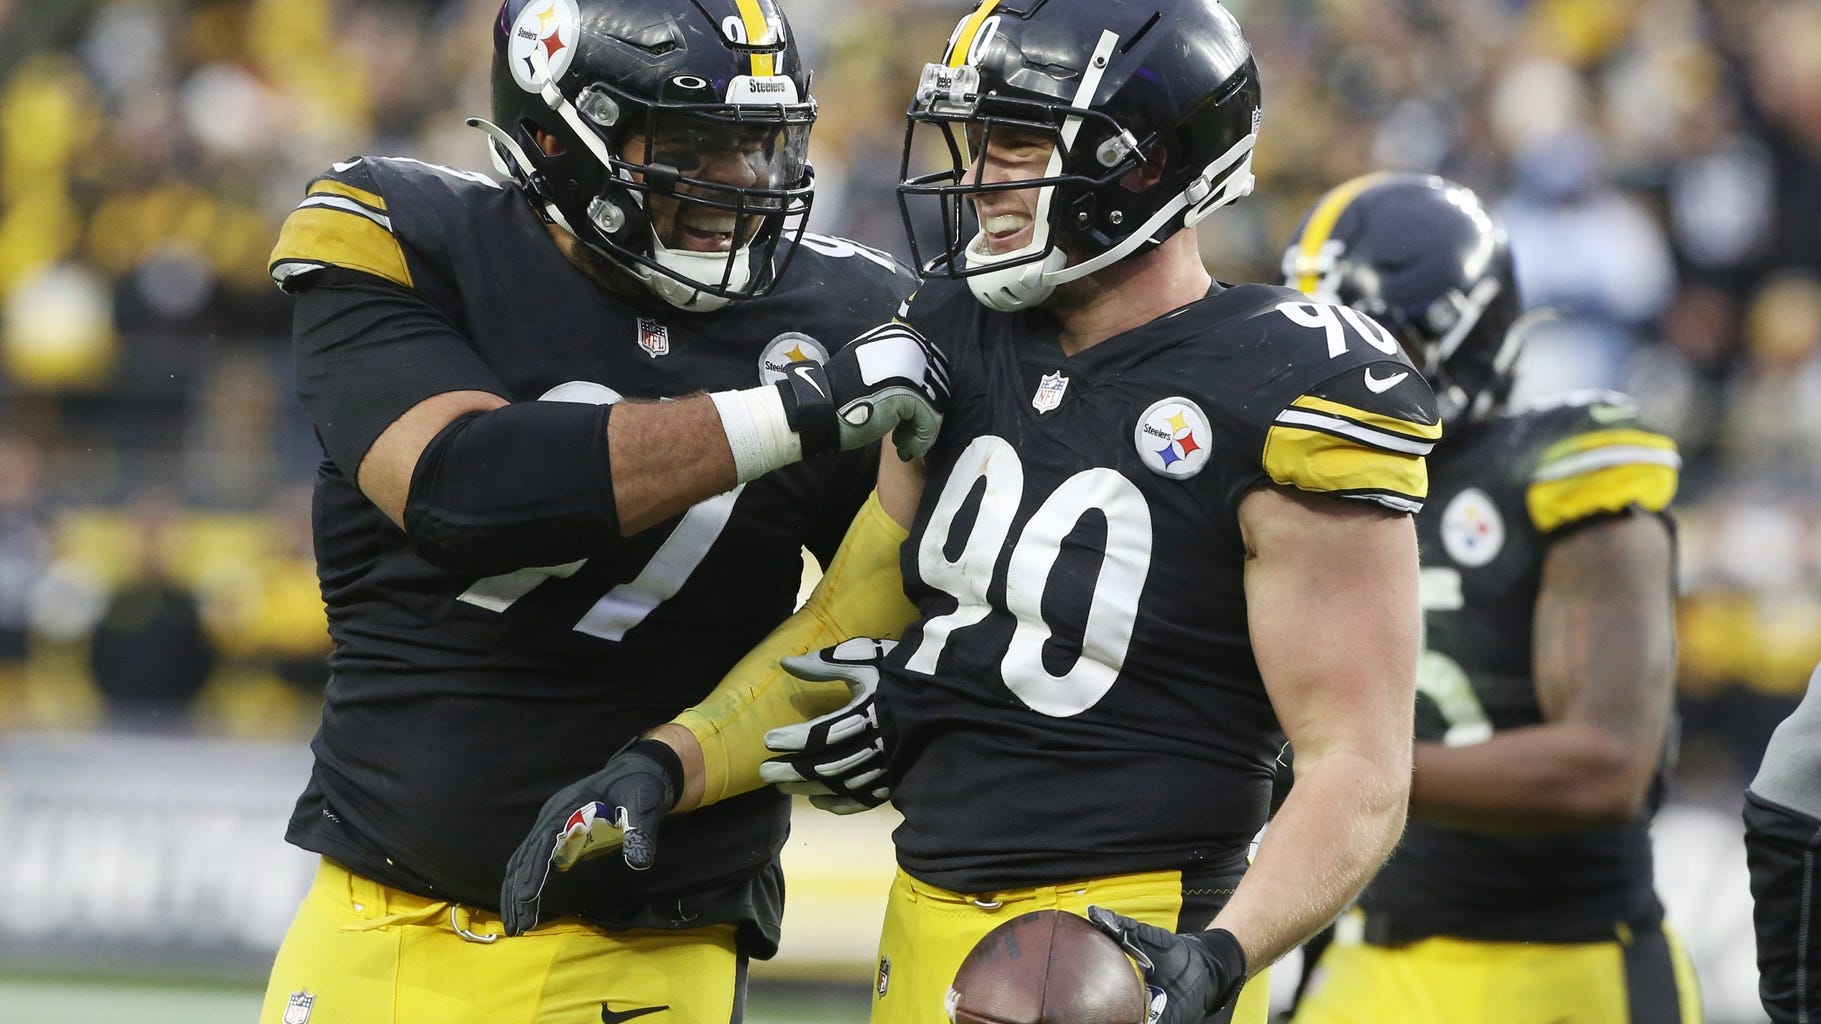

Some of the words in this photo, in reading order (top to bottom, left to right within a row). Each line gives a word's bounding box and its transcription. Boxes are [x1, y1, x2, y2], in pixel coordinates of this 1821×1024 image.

[749, 78, 786, 94] Steelers
[1274, 301, 1398, 360] 90
[765, 360, 787, 374] Steele
[1037, 389, 1058, 406] NFL
[1143, 423, 1172, 441] Steelers
[904, 434, 1153, 718] 90
